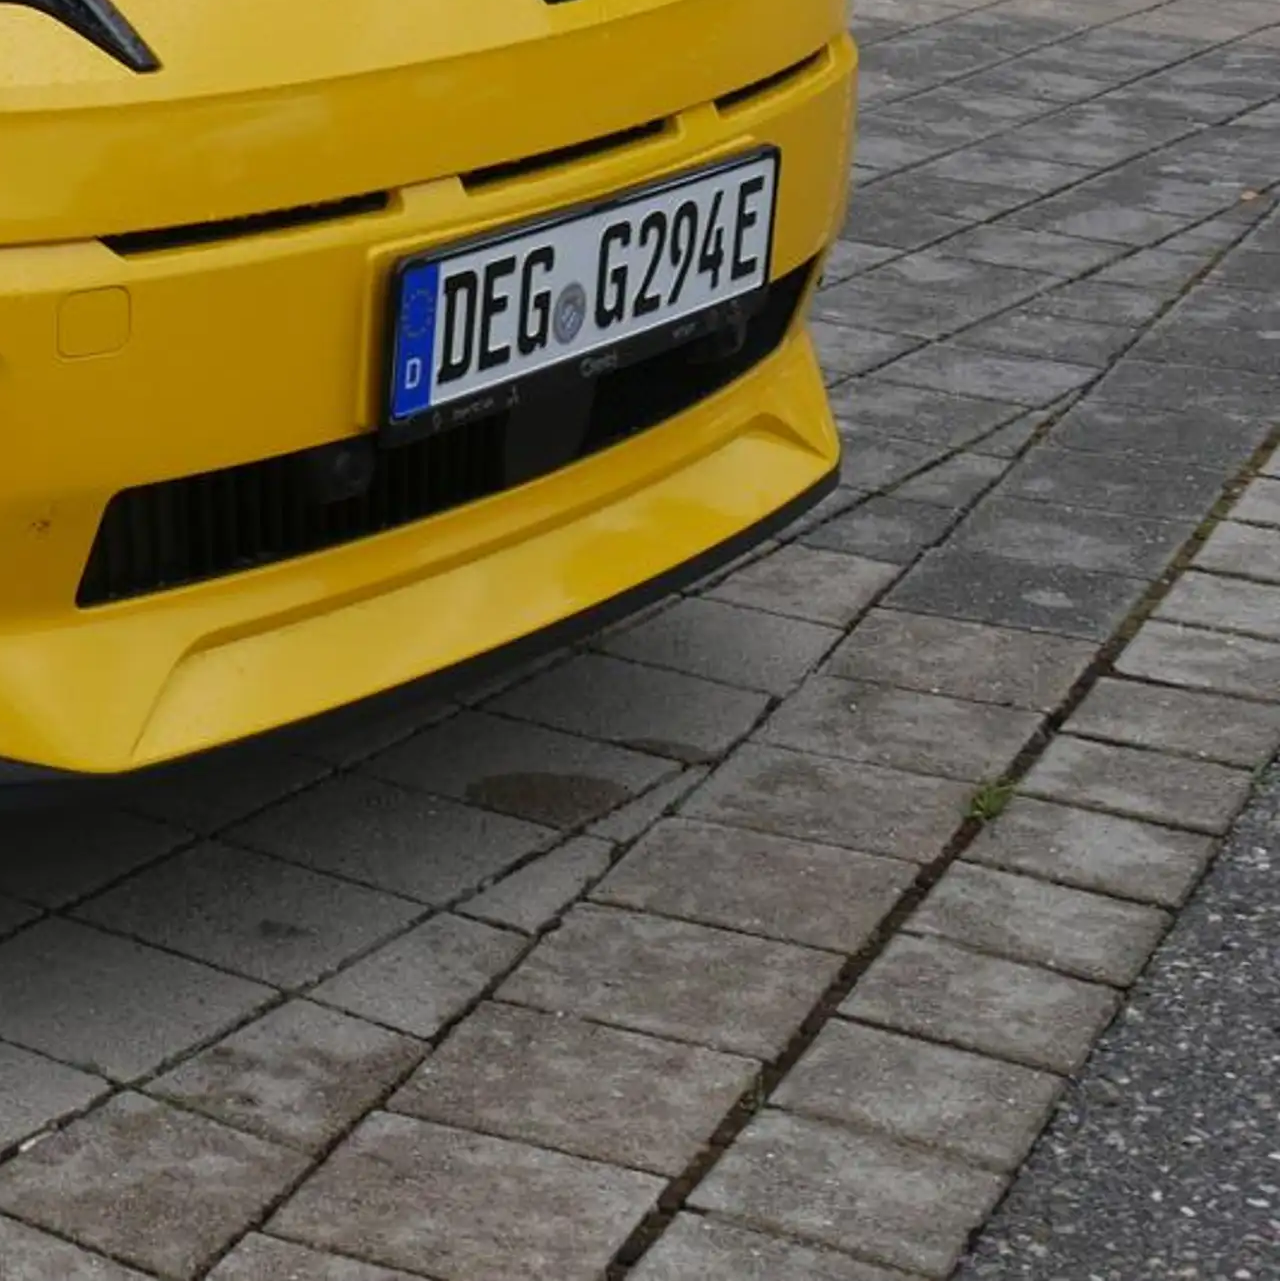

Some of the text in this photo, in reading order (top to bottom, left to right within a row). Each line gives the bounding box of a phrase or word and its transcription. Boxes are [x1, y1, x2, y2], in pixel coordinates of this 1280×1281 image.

[436, 175, 766, 385] DEG G294E
[404, 357, 422, 391] D
